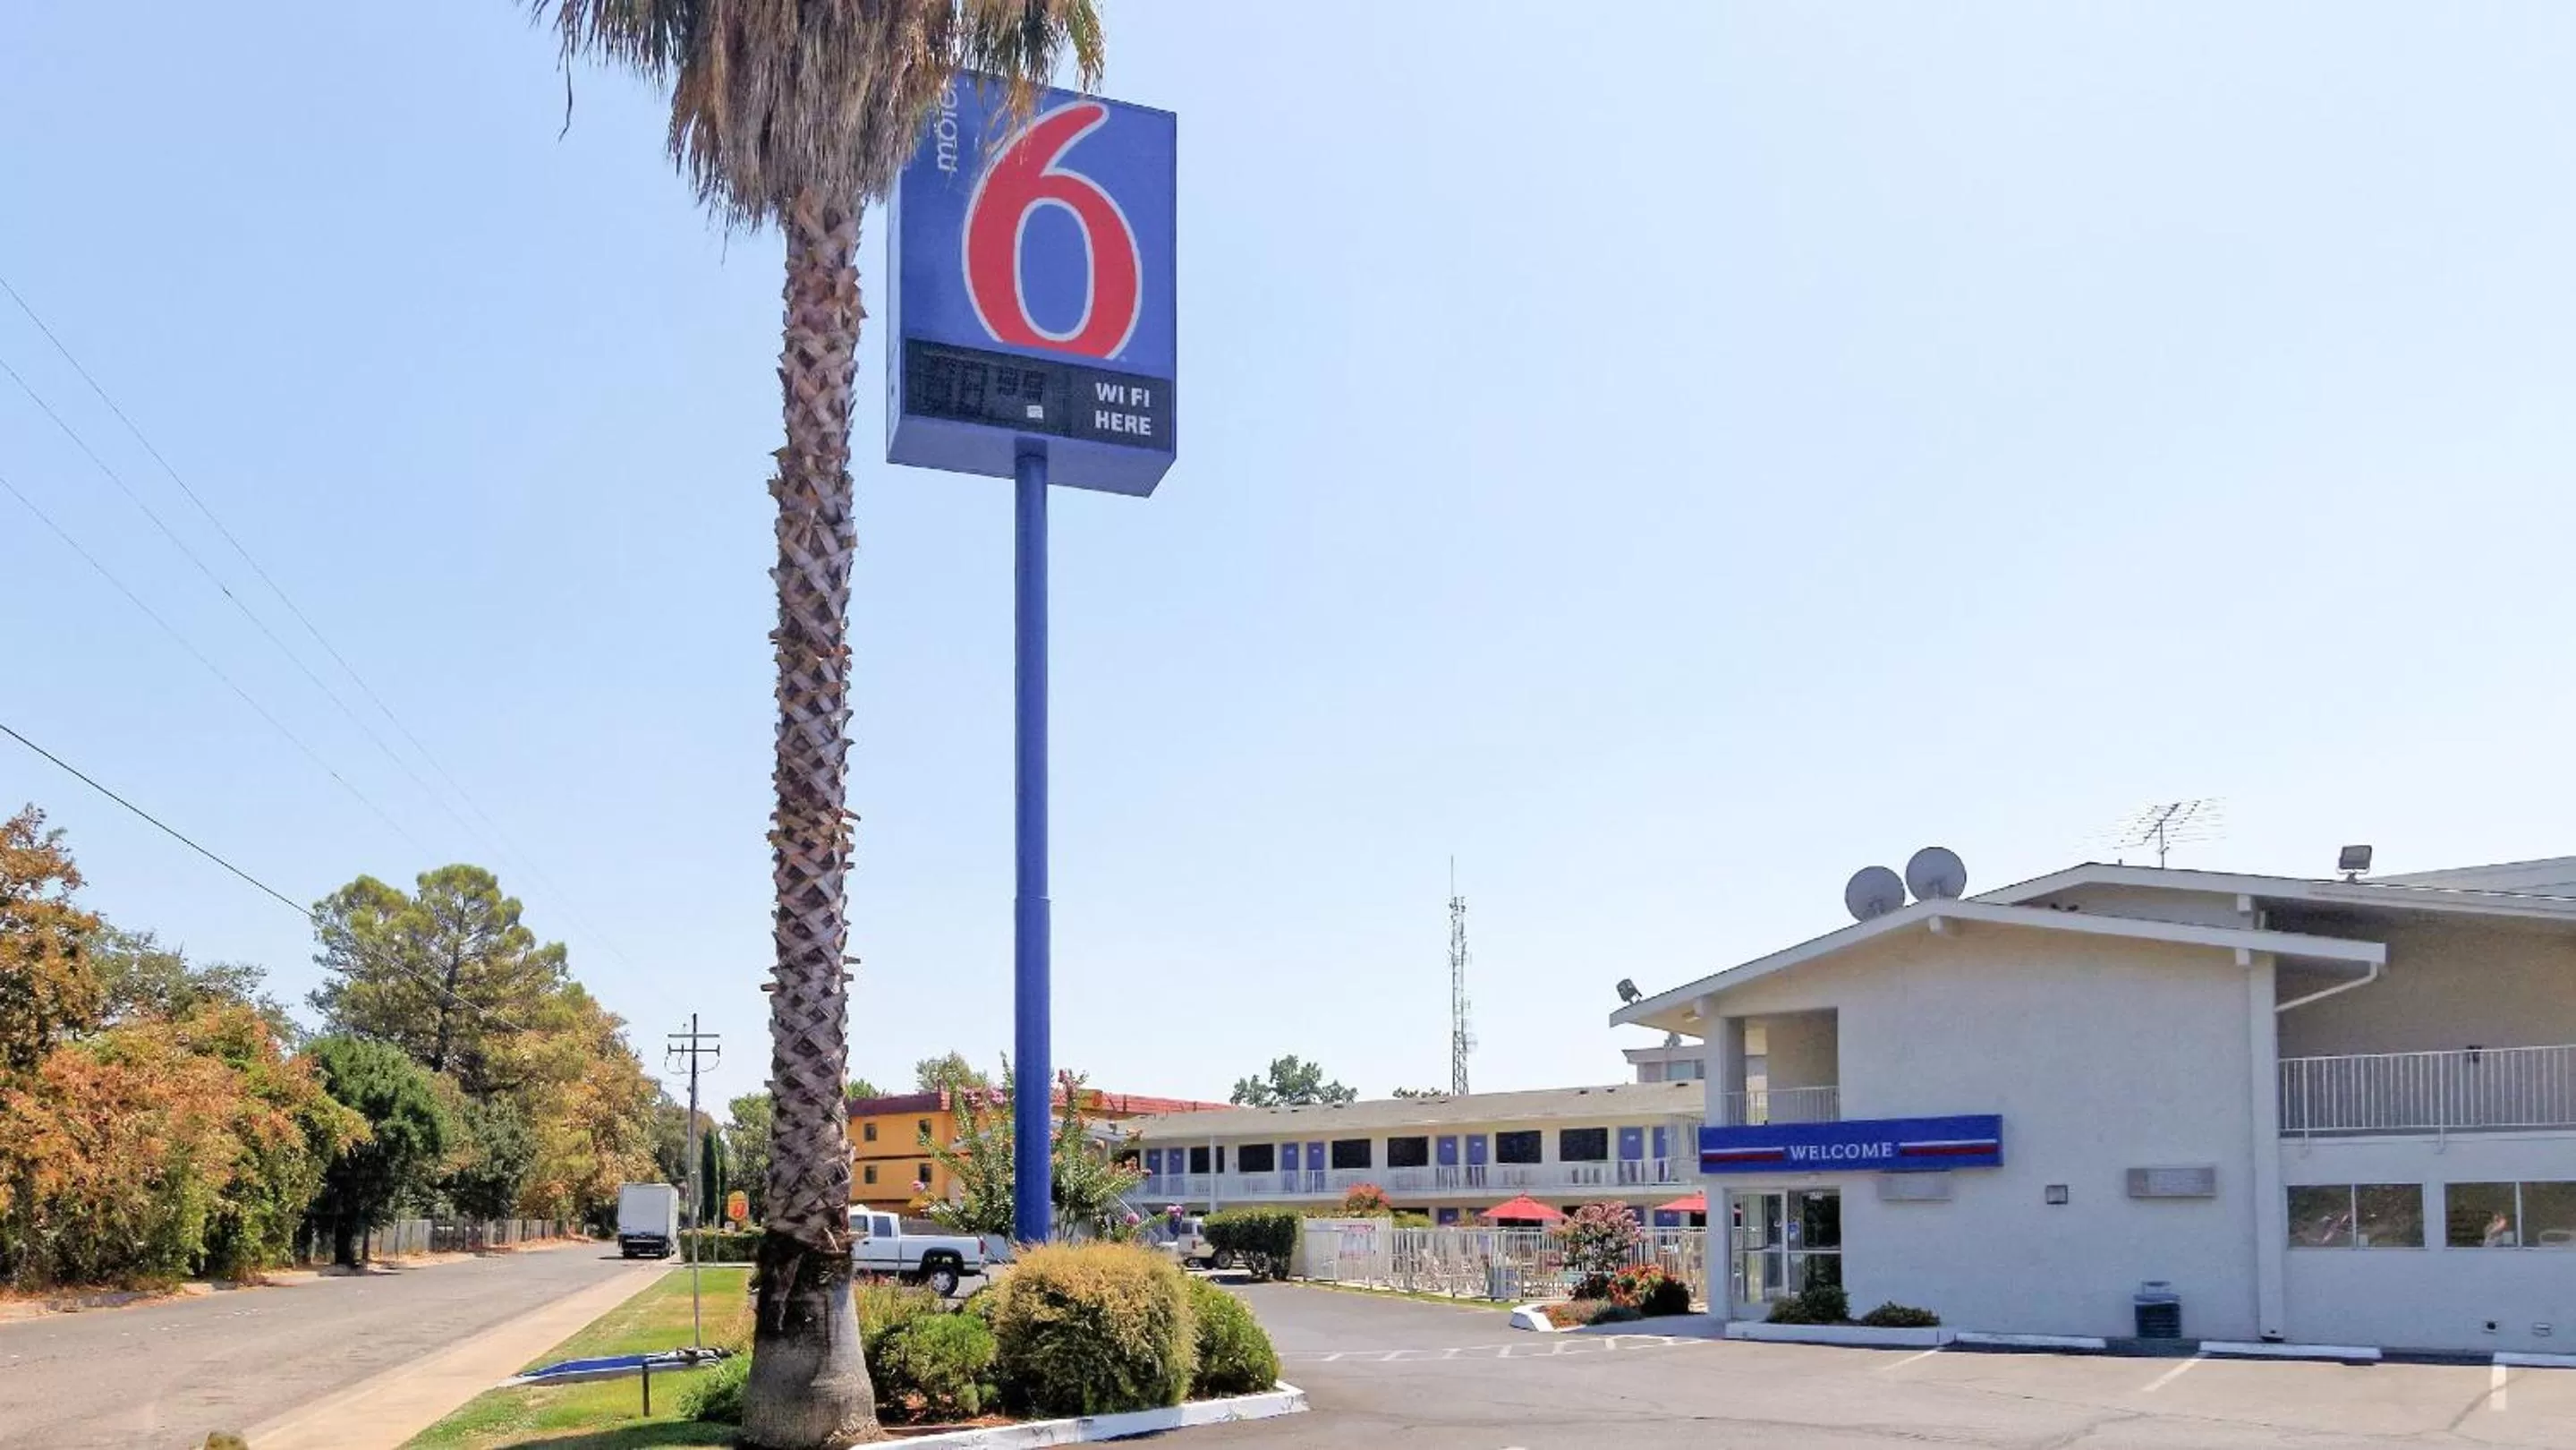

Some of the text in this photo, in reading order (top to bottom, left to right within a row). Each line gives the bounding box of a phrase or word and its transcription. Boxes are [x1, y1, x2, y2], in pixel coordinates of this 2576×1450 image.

[937, 82, 957, 172] mote
[962, 101, 1142, 360] 6
[1095, 382, 1150, 407] WI FI
[1095, 410, 1152, 435] HERE
[1790, 1142, 1893, 1160] WELCOME
